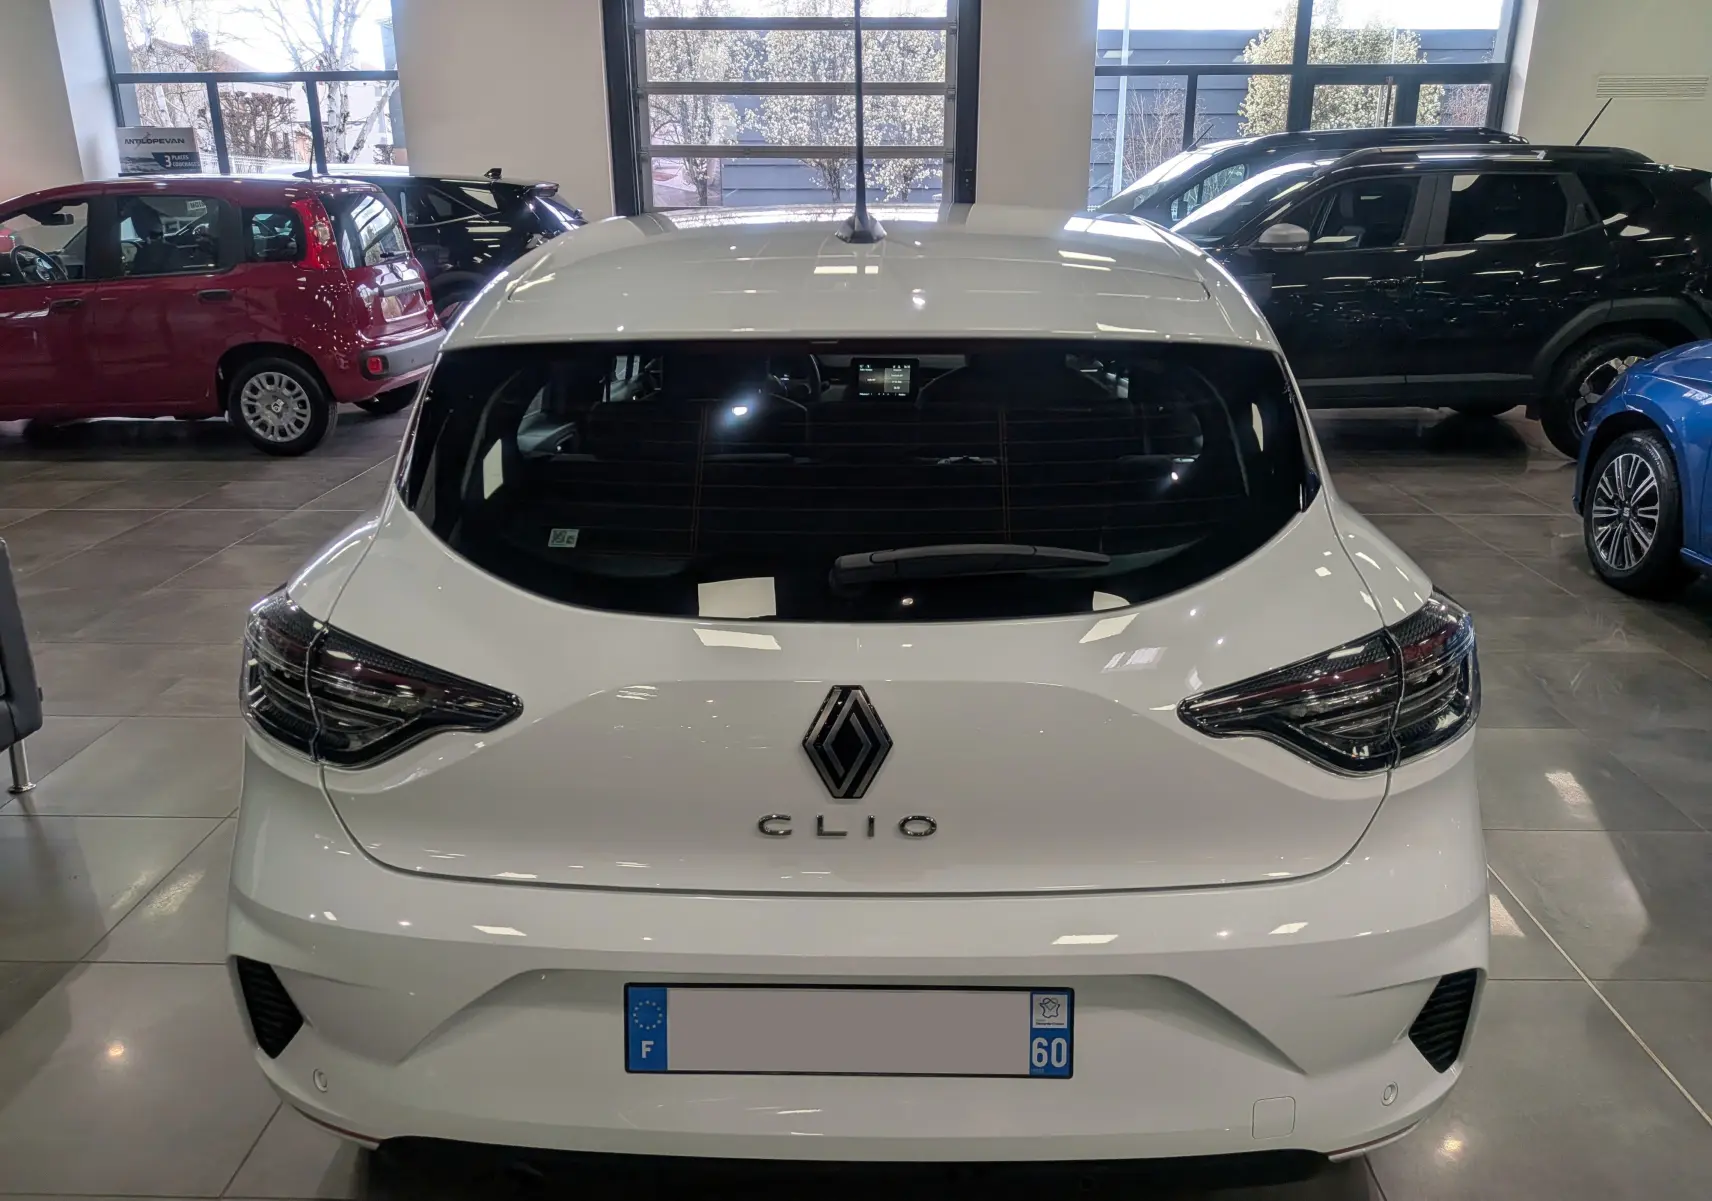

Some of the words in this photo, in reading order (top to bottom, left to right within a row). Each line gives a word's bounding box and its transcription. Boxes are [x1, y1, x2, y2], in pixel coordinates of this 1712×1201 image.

[164, 155, 172, 168] 3
[758, 814, 937, 838] CLIO
[641, 1040, 654, 1059] F
[1032, 1037, 1067, 1068] 60
